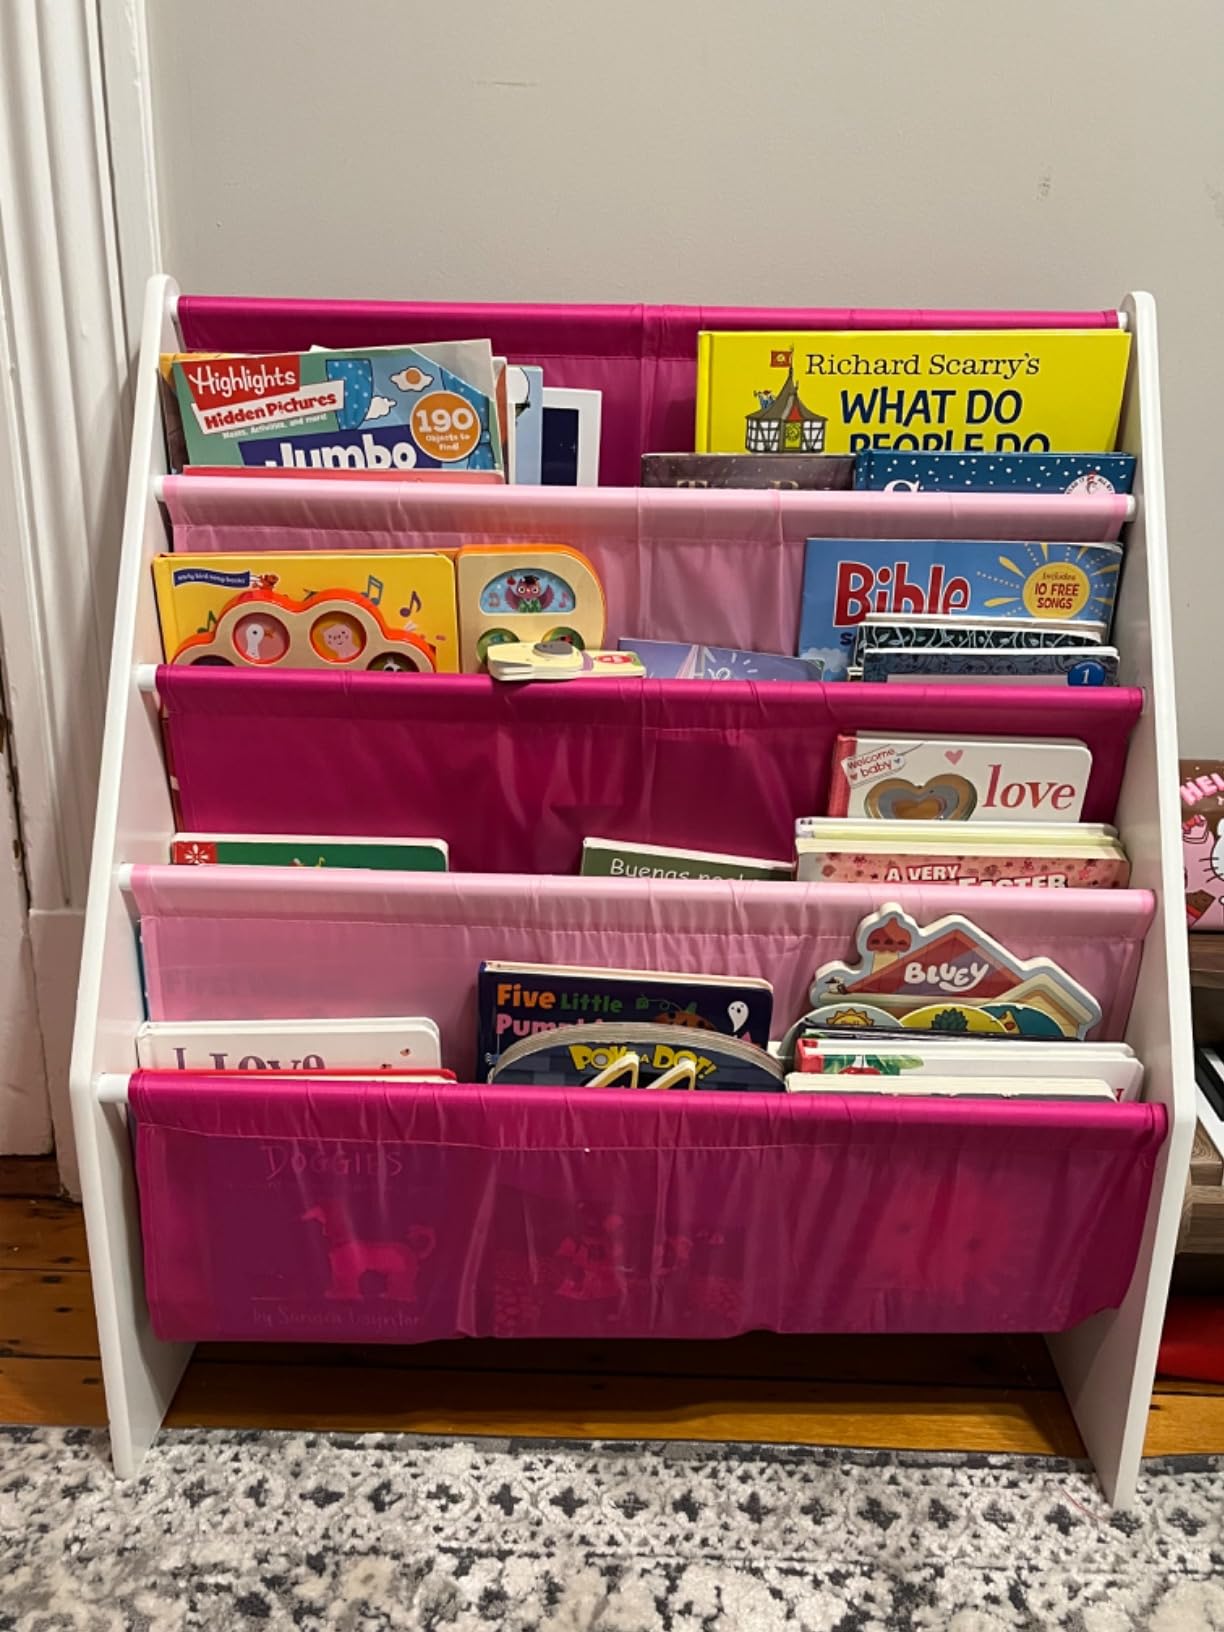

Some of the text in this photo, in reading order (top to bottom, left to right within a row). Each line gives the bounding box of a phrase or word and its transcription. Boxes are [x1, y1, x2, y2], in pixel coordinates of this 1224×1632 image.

[805, 353, 1040, 380] Richard Scarry's
[188, 364, 296, 398] Highlights
[204, 393, 337, 429] Hidden Pictures
[416, 407, 474, 433] 190
[840, 386, 1023, 427] WHAT DO
[265, 433, 418, 468] Jumbo
[833, 560, 971, 628] Bible
[1034, 582, 1080, 596] 10 FREE
[1036, 597, 1073, 609] SONGS
[1081, 667, 1090, 684] 1
[847, 748, 896, 769] Welcome
[860, 760, 892, 778] baby
[982, 764, 1076, 811] love
[609, 857, 690, 880] Buenas
[887, 864, 961, 882] A VERY
[904, 962, 990, 992] BLUEY
[496, 983, 624, 1013] Five Little
[568, 1043, 630, 1070] POK
